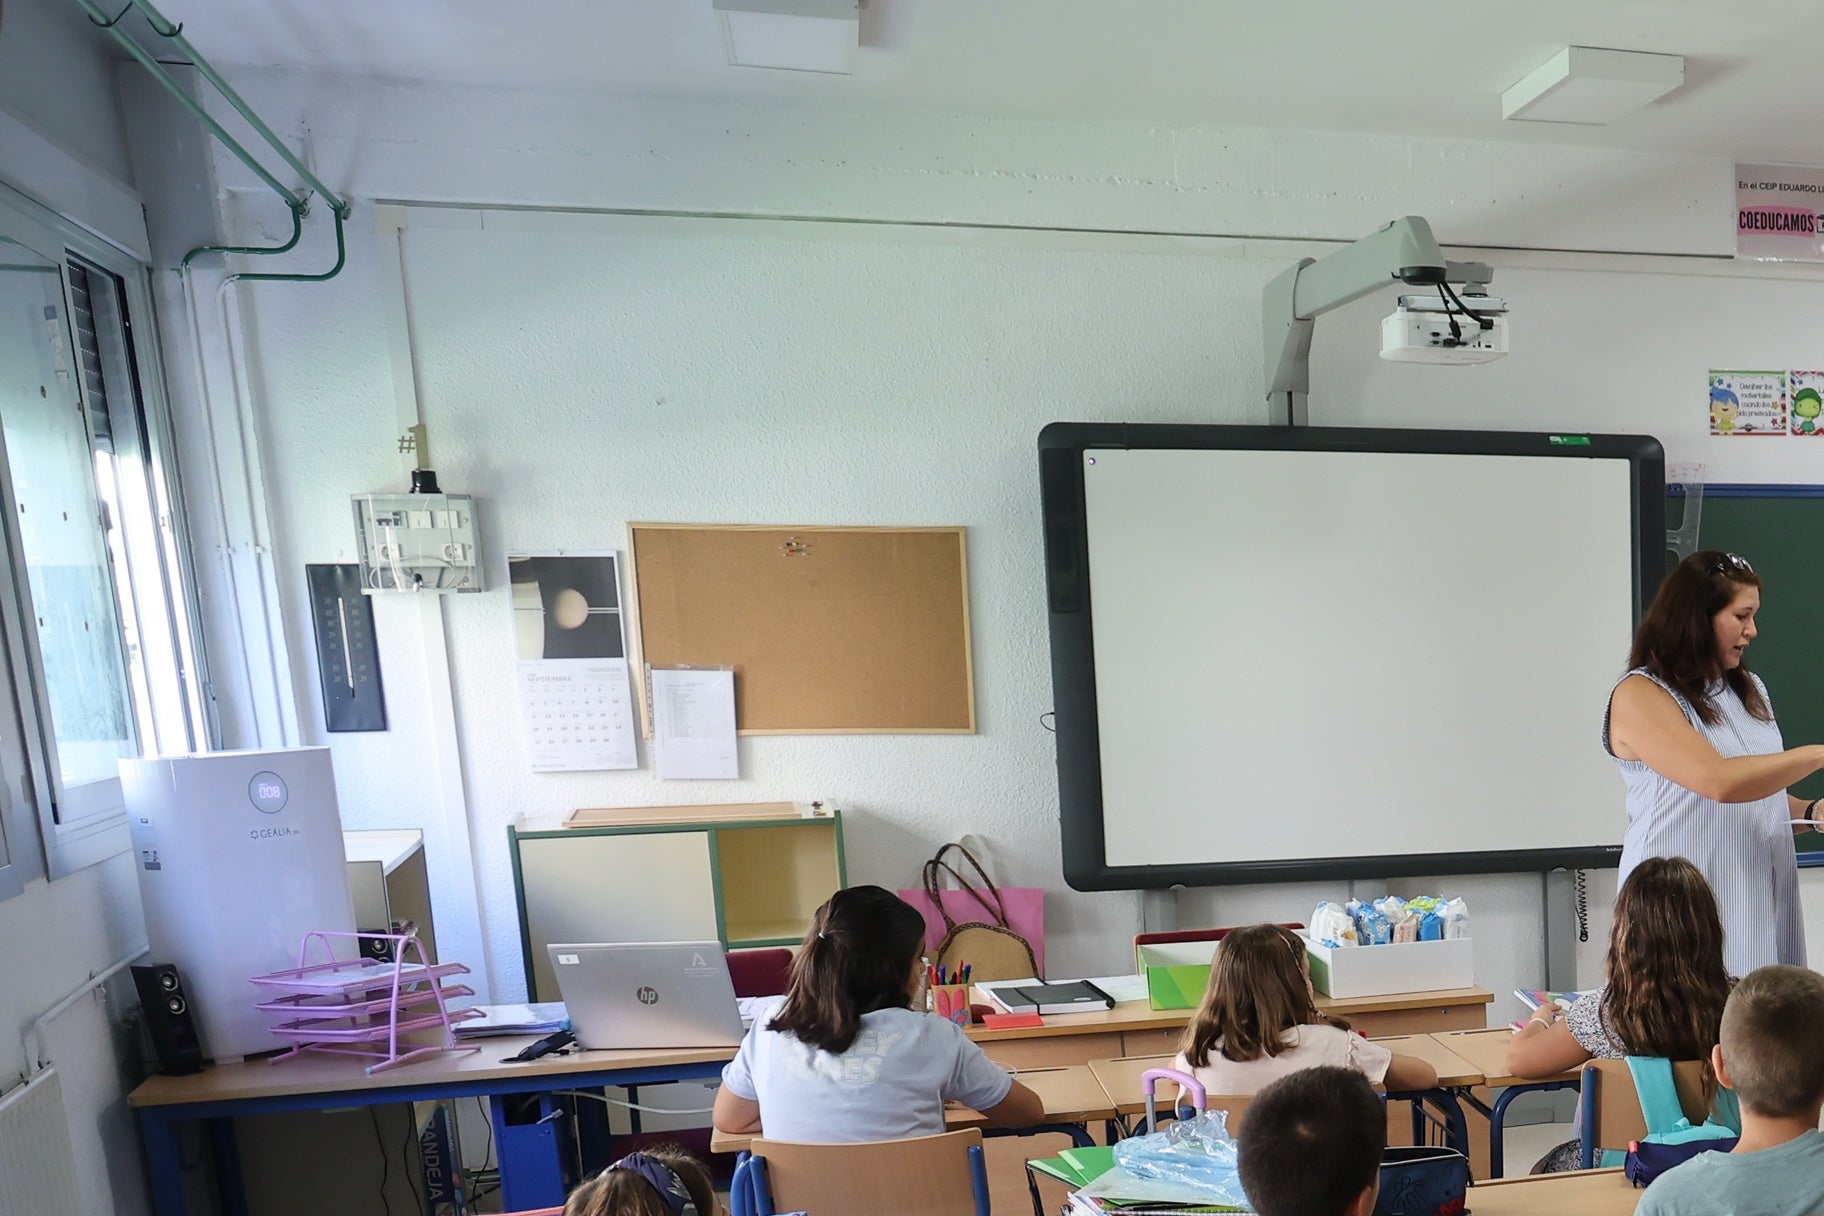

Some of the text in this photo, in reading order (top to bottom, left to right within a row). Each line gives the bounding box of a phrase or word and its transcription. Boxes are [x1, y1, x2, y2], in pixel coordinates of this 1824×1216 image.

[1739, 181, 1748, 189] En
[1759, 182, 1777, 191] CEIP
[1779, 183, 1817, 193] EDUARDO
[1739, 211, 1815, 233] COEDUCAMOS
[258, 785, 281, 799] 008
[259, 827, 292, 839] GEALIA
